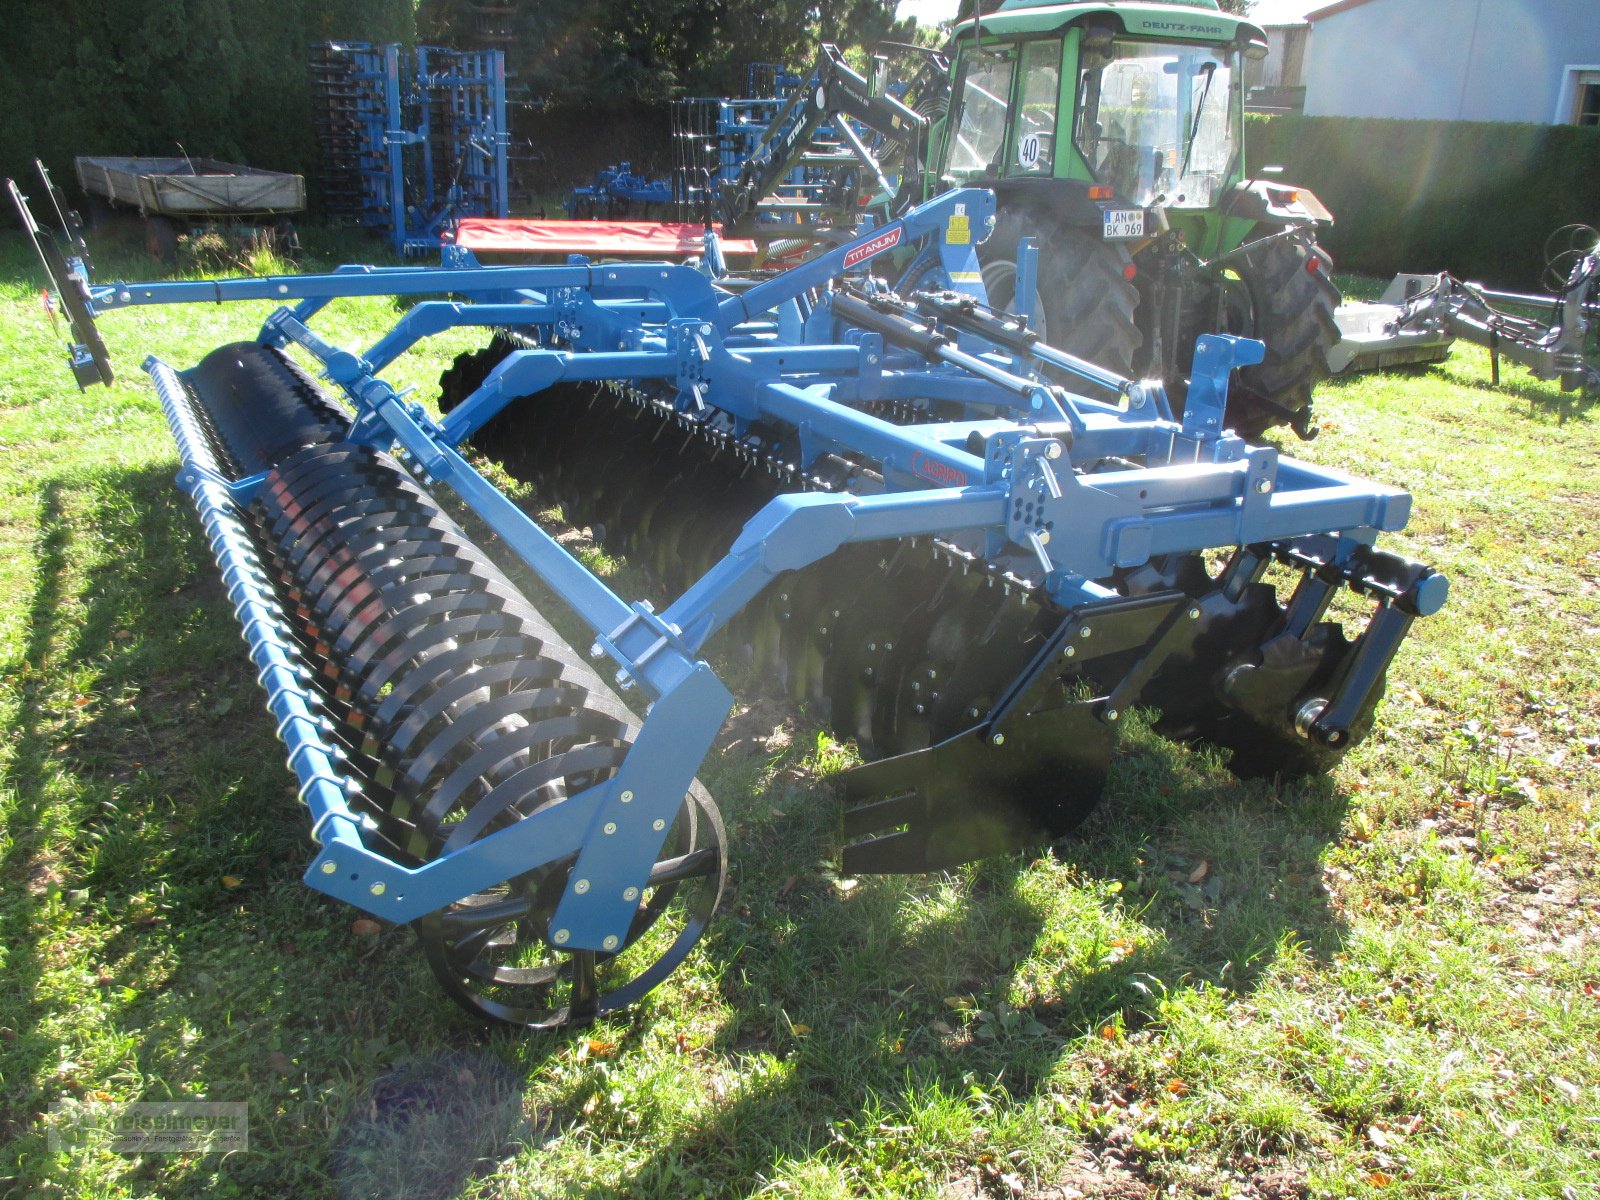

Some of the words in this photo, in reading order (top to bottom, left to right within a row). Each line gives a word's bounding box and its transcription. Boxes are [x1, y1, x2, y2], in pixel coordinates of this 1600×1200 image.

[1022, 138, 1037, 162] 40
[1114, 212, 1127, 224] AN
[1106, 224, 1119, 236] BK
[1124, 223, 1142, 235] 969
[849, 233, 896, 262] TITANUM
